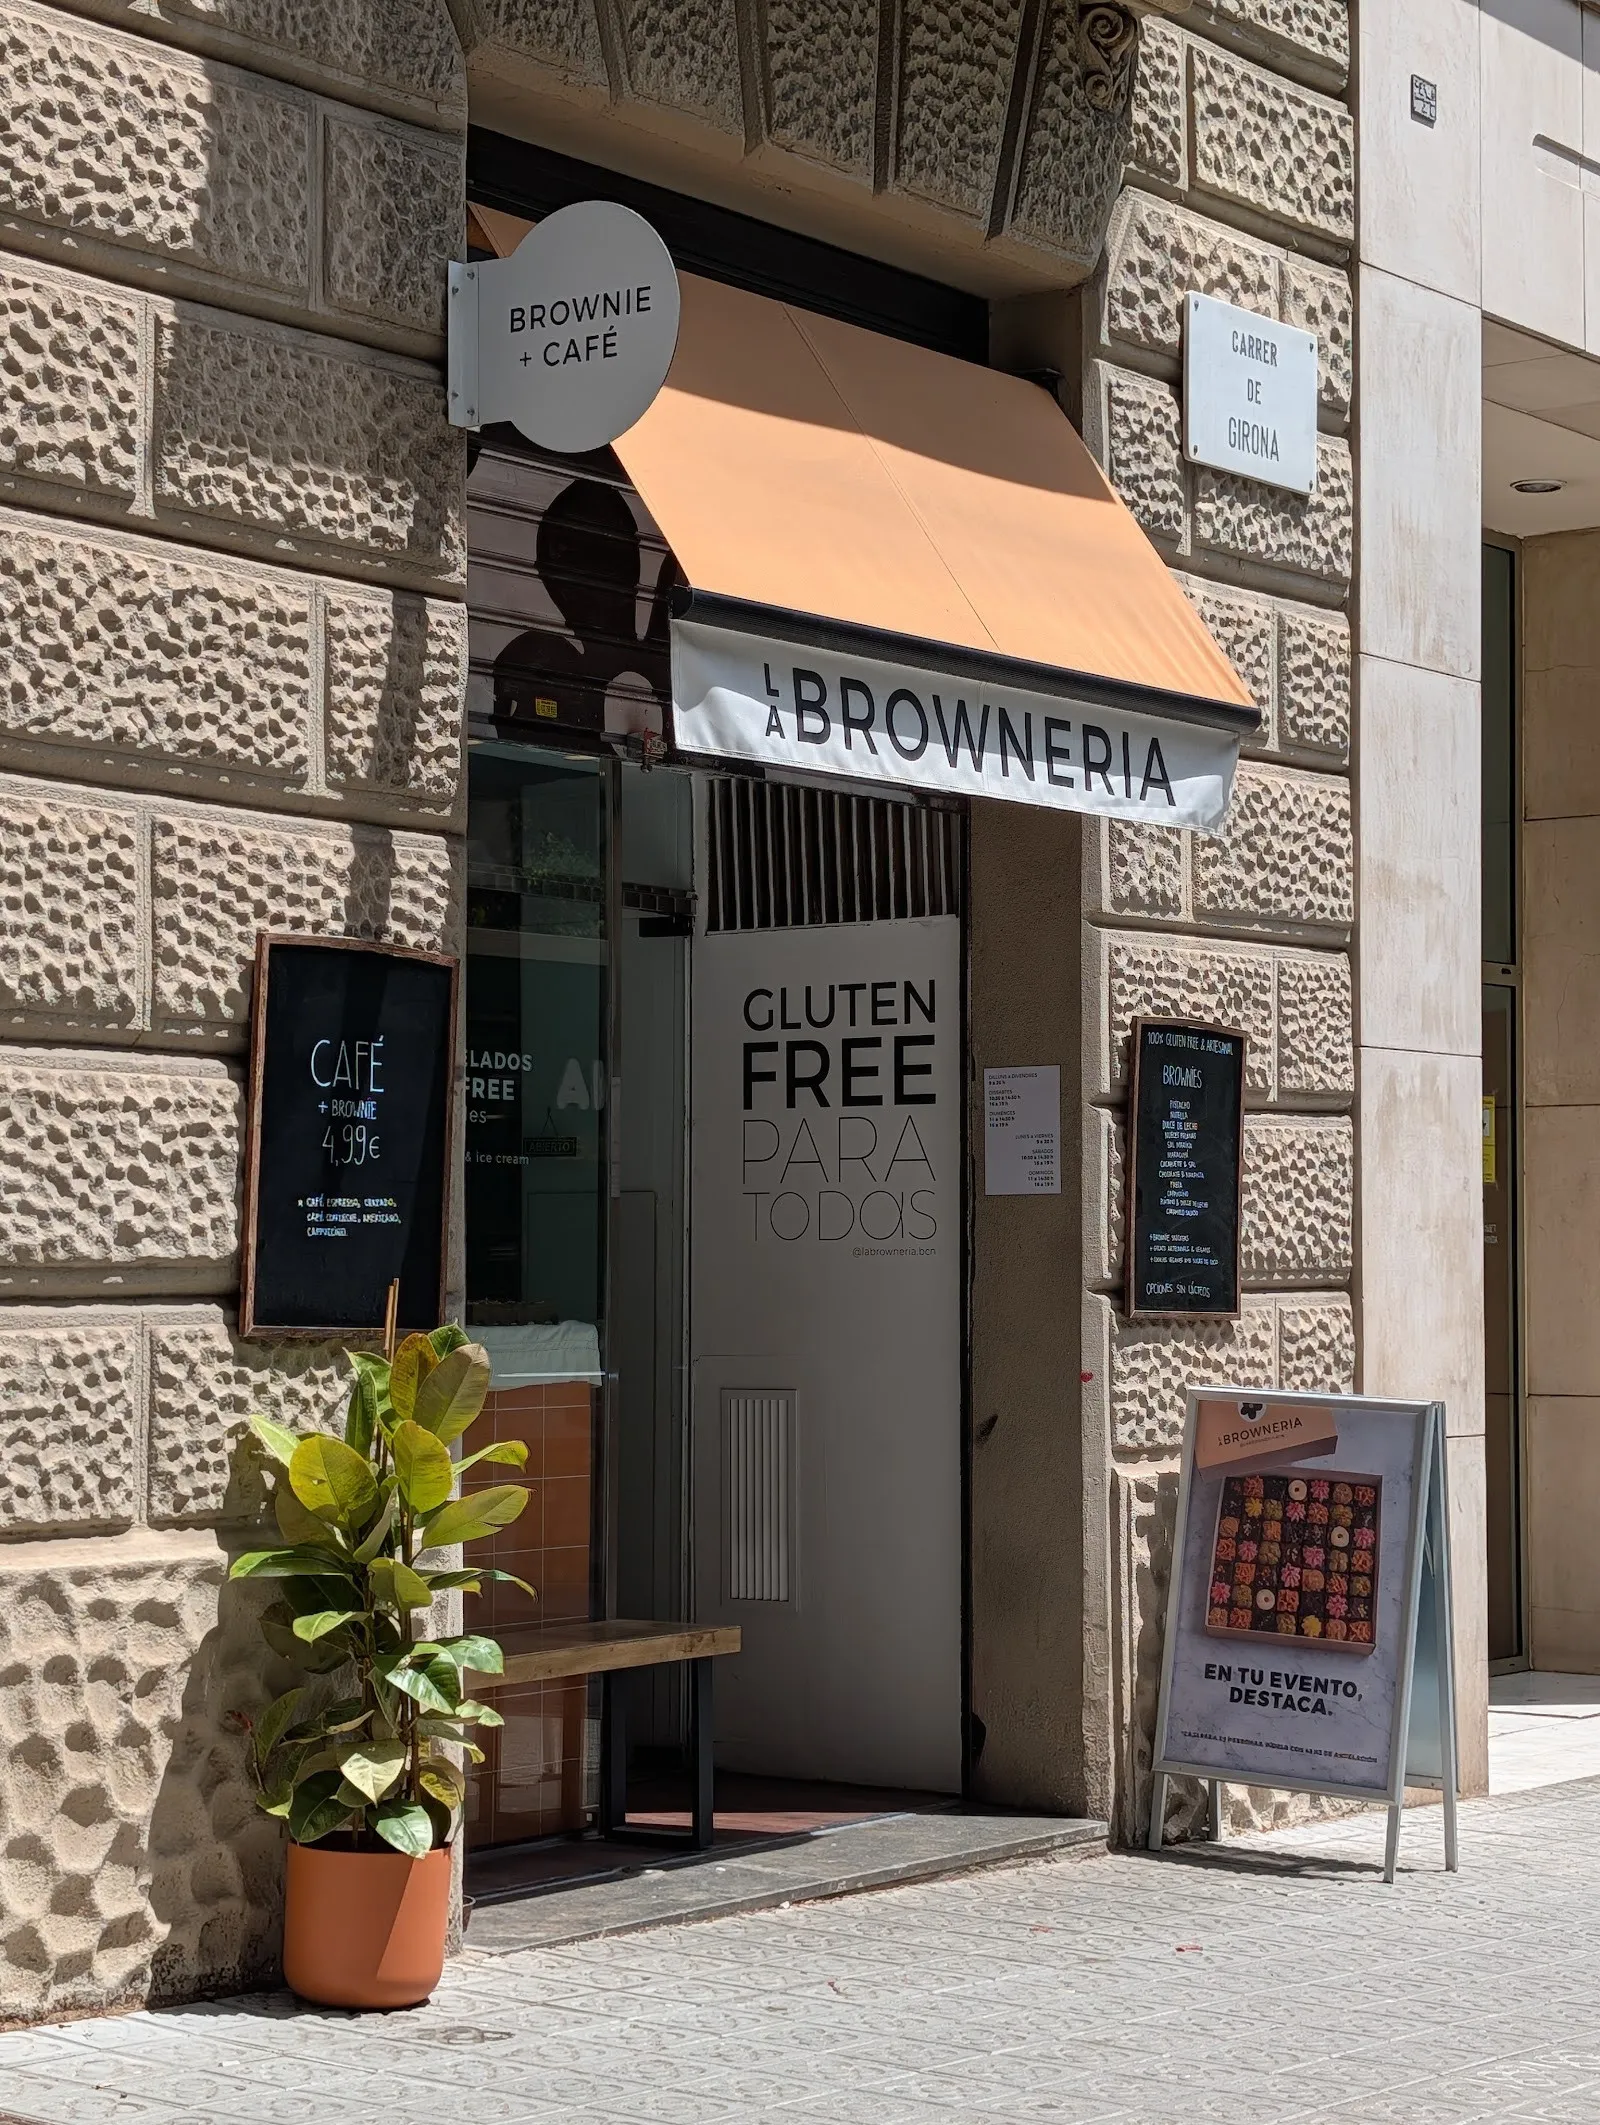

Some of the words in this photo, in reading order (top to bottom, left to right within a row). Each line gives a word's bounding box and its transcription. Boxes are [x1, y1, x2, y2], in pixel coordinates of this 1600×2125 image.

[510, 286, 651, 333] BROWNIE
[519, 351, 532, 367] +
[543, 325, 618, 367] CAFÉ
[1231, 330, 1278, 367] CARRER
[1247, 378, 1262, 405] DE
[1228, 416, 1280, 462] GIRONA
[793, 667, 1176, 807] BROWNERIA
[743, 979, 936, 1031] GLUTEN
[1147, 1031, 1164, 1045] 100%
[1165, 1033, 1186, 1048] GLUTEN
[1187, 1036, 1199, 1050] FREE
[311, 1035, 385, 1092] CAFÉ
[743, 1034, 936, 1110] FREE
[1163, 1065, 1202, 1089] BROWNIES
[318, 1100, 329, 1114] +
[331, 1098, 377, 1120] BROWNIE
[322, 1124, 380, 1166] 4,99€
[476, 1151, 493, 1163] ice
[495, 1154, 530, 1165] cream
[743, 1115, 936, 1184] PARA
[852, 1246, 936, 1258] @labrowneria.bcn
[1223, 1417, 1303, 1445] BROWNERIA
[1204, 1663, 1232, 1682] EN
[1237, 1667, 1264, 1685] TU
[1270, 1672, 1363, 1701] EVENTO,
[1230, 1687, 1333, 1716] DESTACA.
